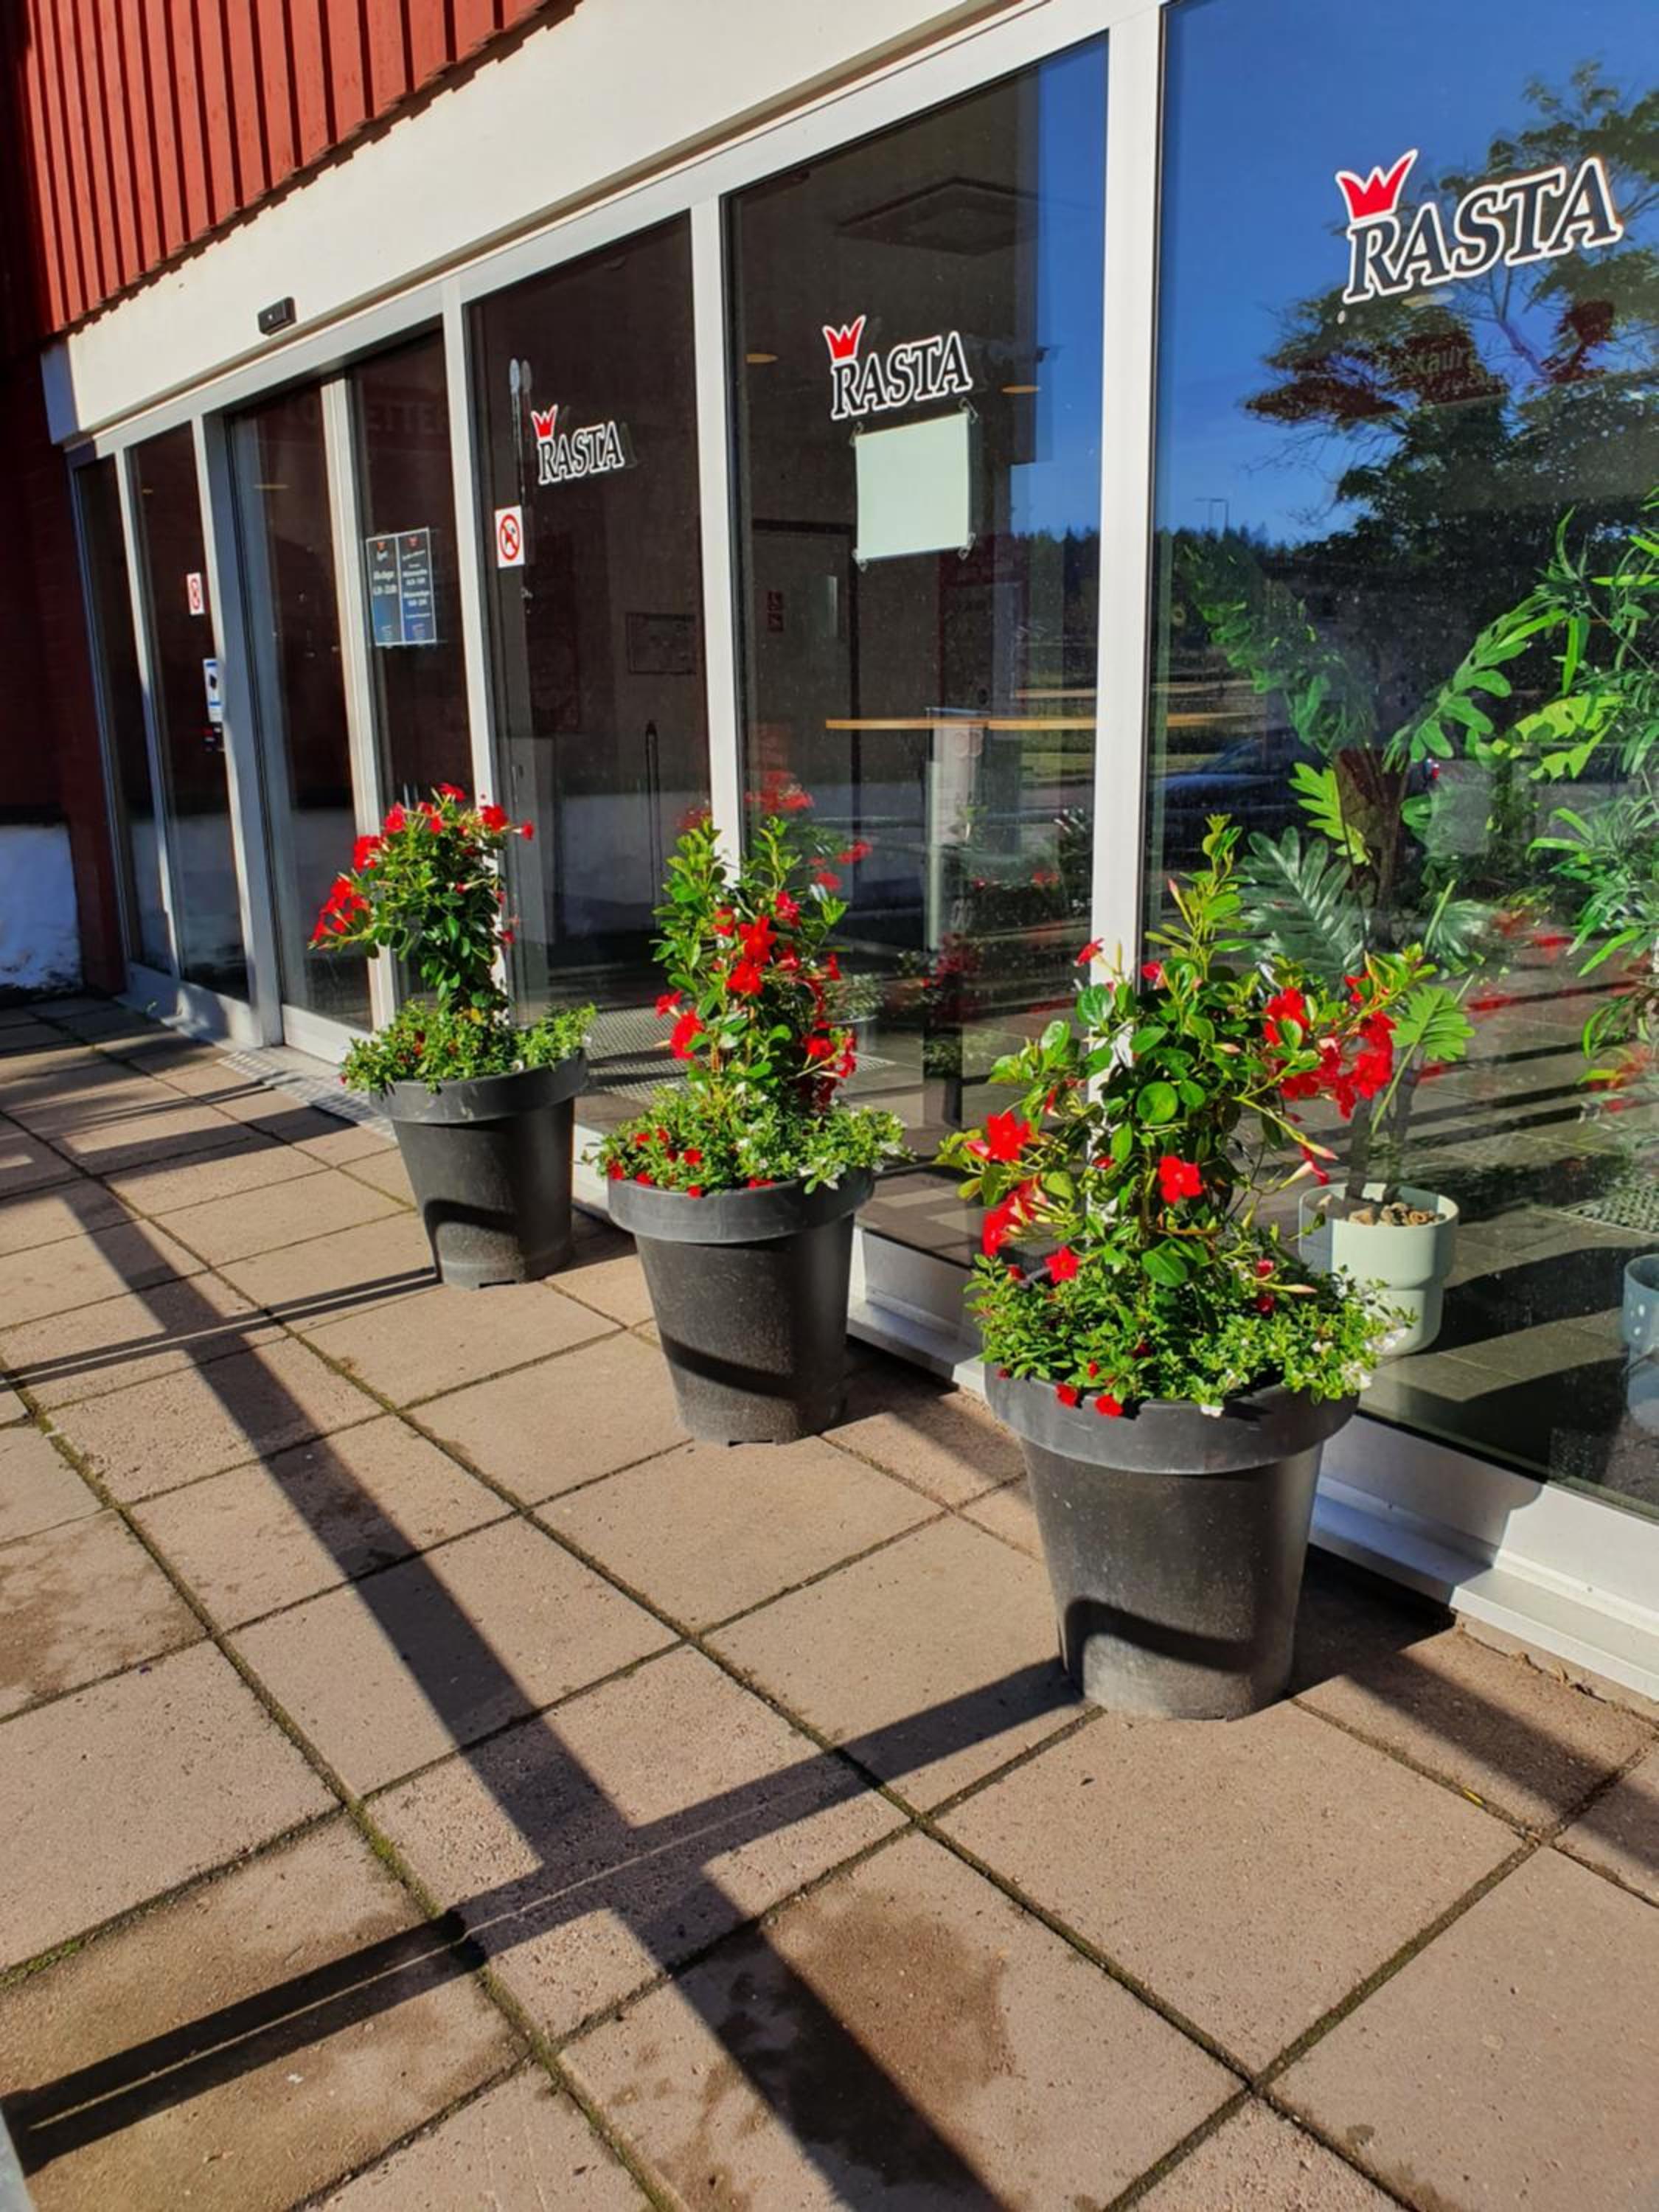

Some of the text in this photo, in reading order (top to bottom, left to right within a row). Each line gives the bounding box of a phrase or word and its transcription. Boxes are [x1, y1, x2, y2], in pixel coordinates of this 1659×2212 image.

[1343, 156, 1624, 304] RASTA
[830, 330, 973, 421] RASTA
[538, 421, 625, 485] RASTA
